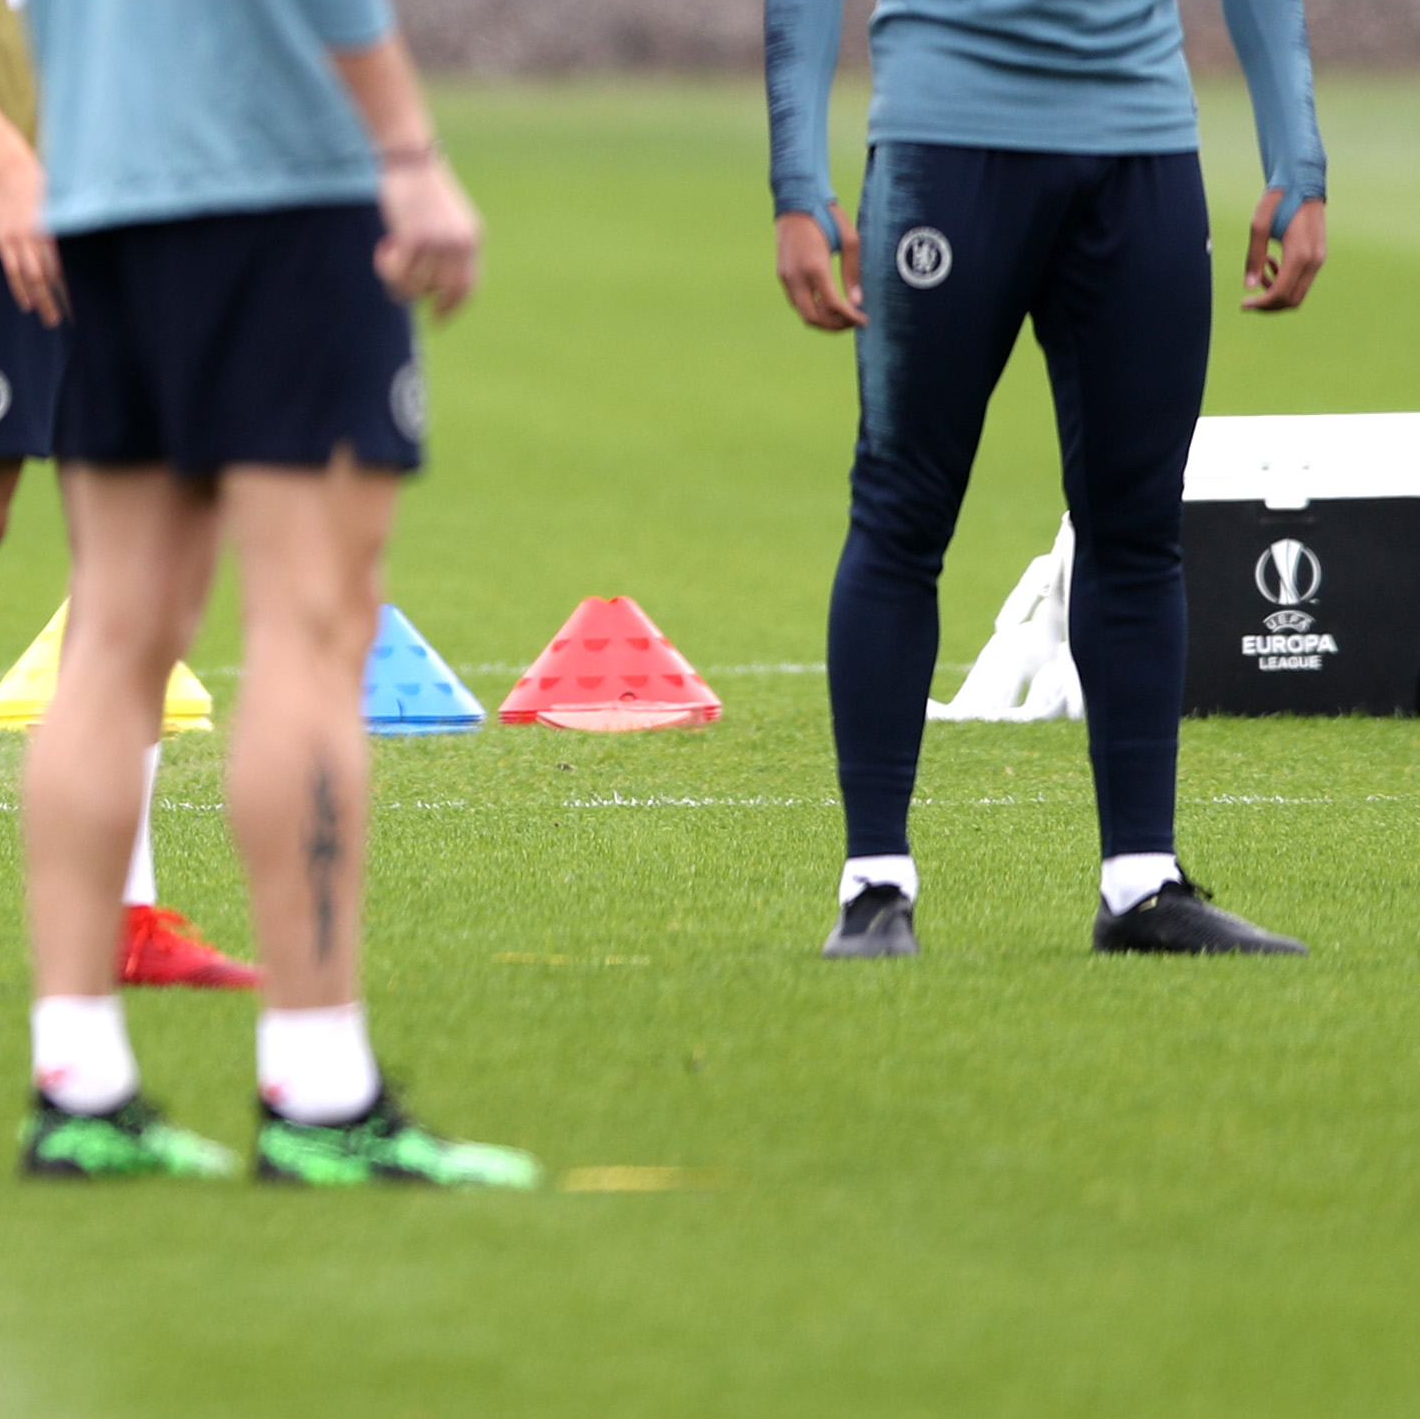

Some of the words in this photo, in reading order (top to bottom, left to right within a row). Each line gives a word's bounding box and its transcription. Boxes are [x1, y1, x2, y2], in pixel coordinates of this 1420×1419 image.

[1265, 612, 1312, 633] UEFA
[1241, 633, 1339, 655] EUROPA
[1258, 655, 1323, 672] LEAGUE
